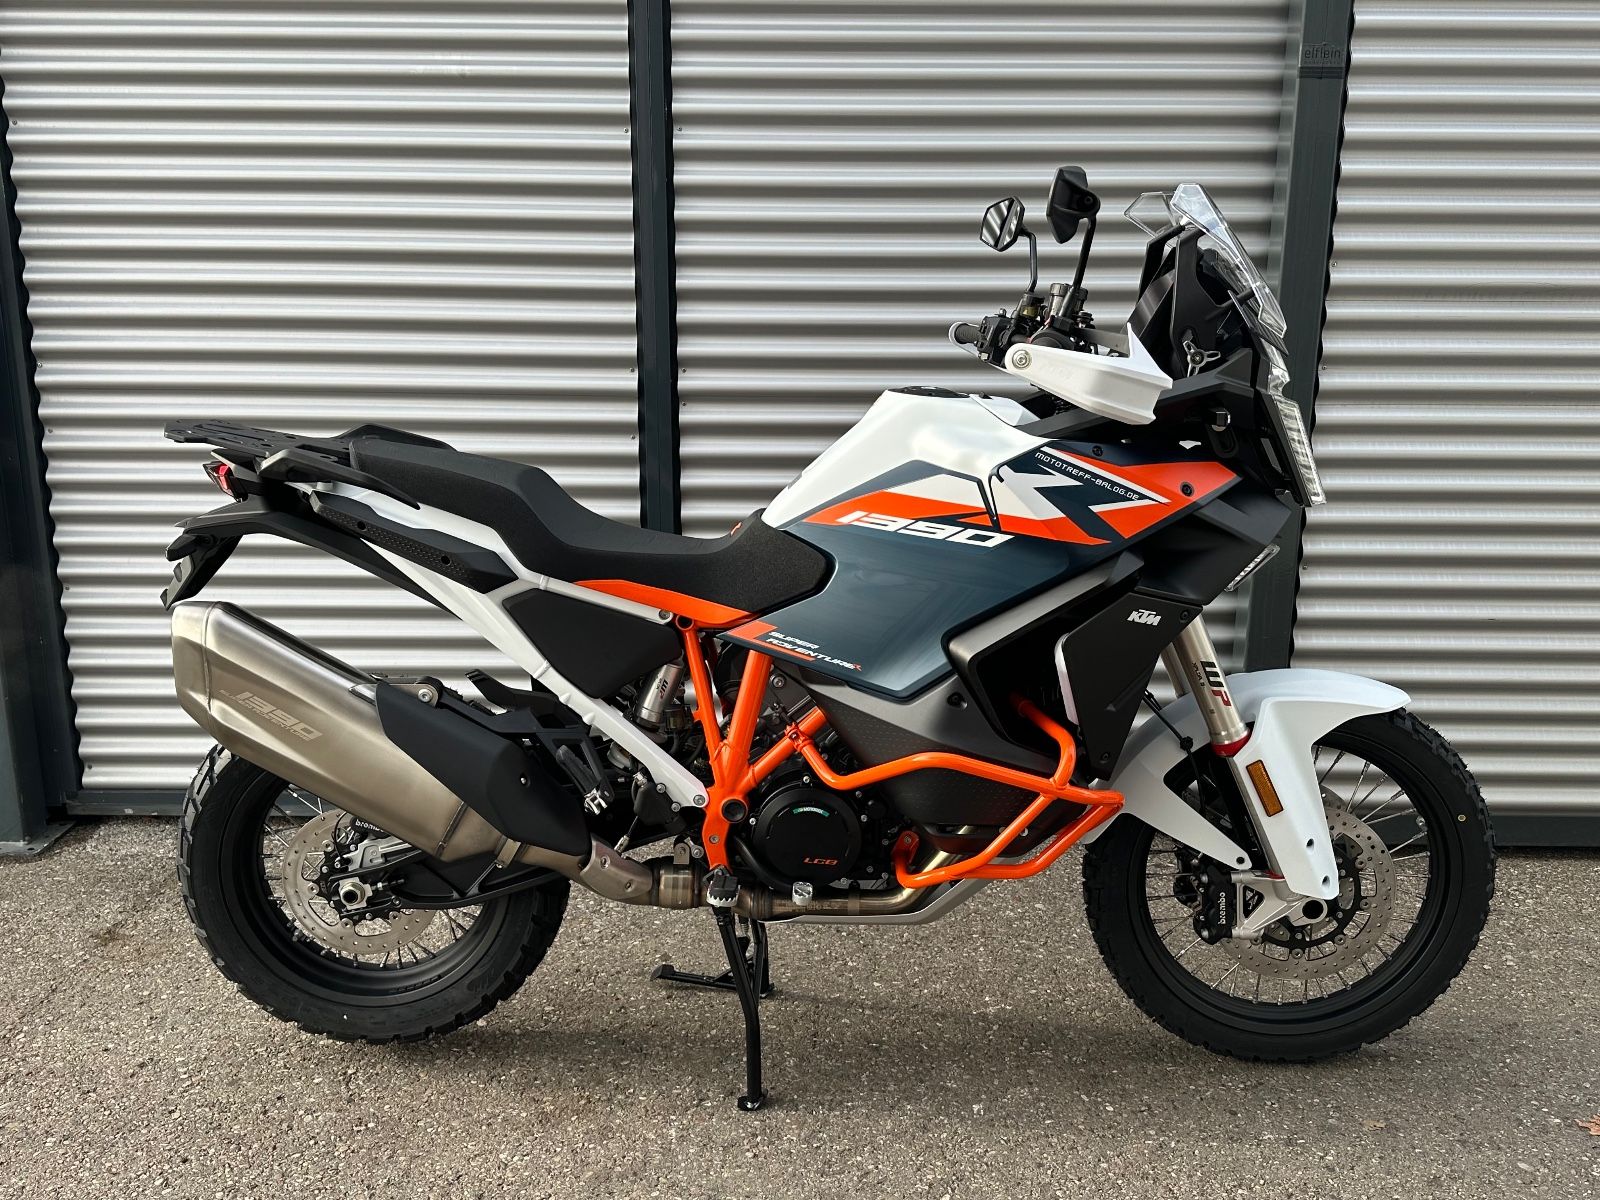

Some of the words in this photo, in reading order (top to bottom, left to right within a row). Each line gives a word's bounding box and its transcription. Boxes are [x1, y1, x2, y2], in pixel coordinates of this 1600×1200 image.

[1034, 452, 1140, 501] MOTOTREFF-BALOG.DE
[1126, 609, 1162, 626] KTM
[768, 631, 820, 649] SUPER
[1200, 660, 1232, 707] WP
[1217, 891, 1226, 925] brembo
